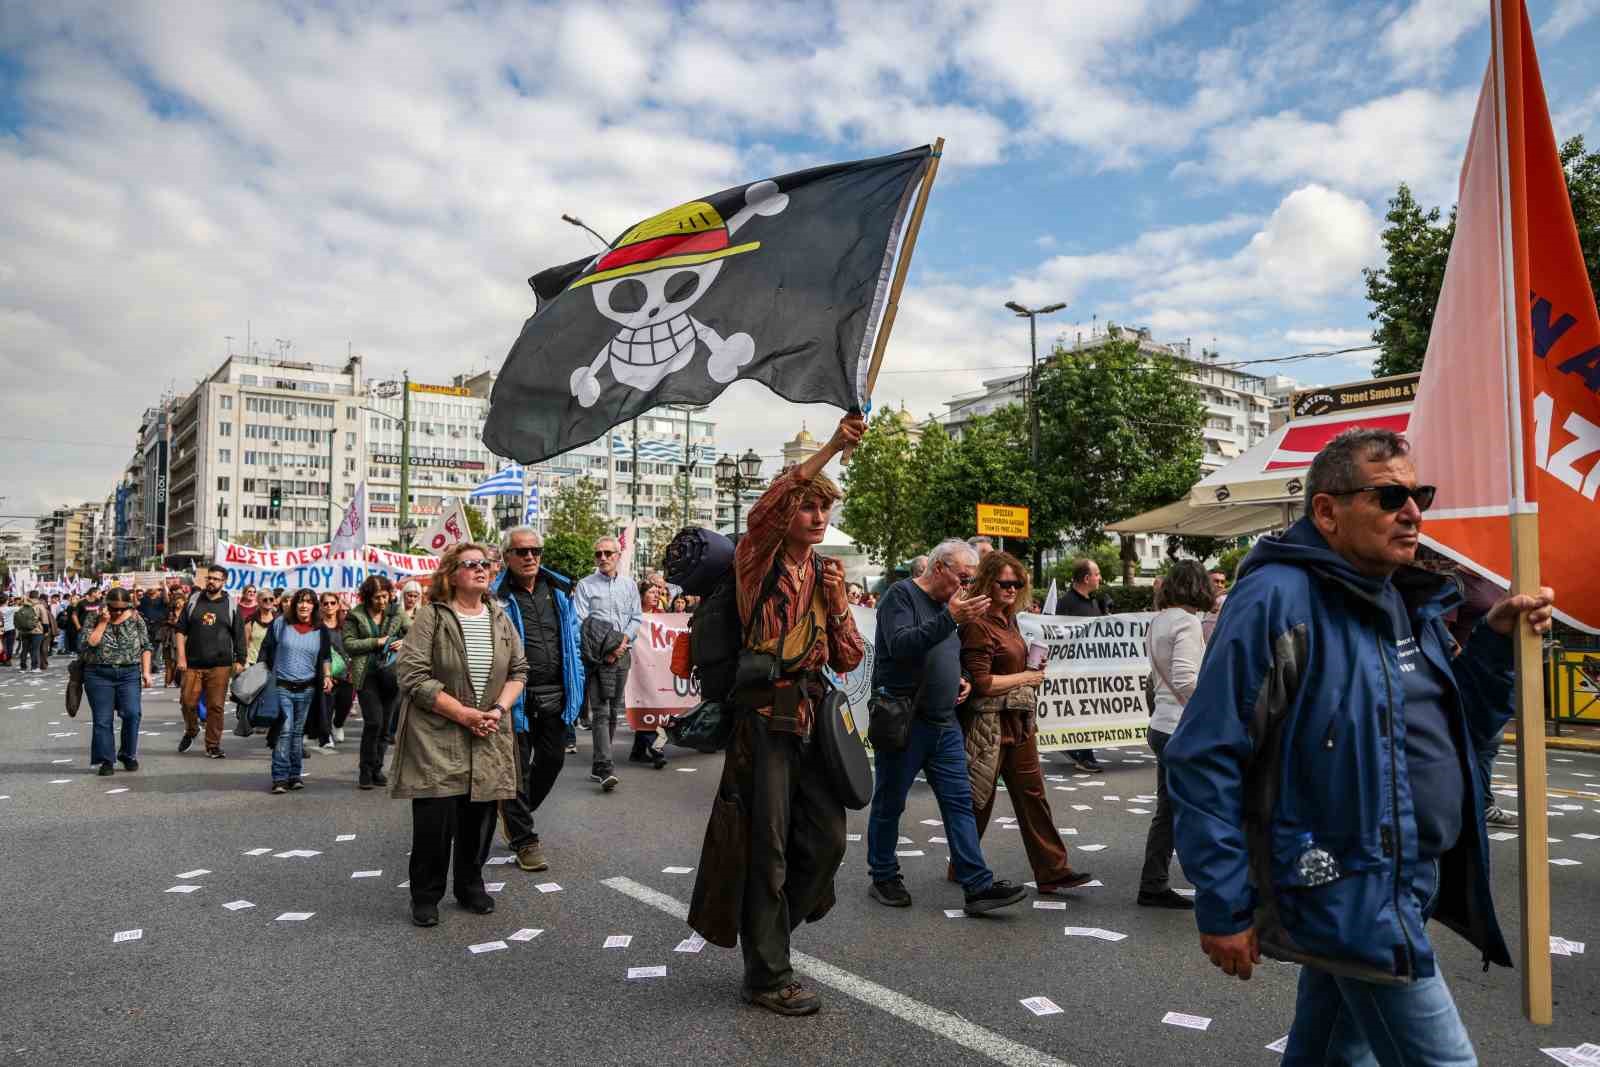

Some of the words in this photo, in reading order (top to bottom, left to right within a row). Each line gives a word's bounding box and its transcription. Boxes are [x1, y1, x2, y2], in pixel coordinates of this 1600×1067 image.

[1340, 391, 1369, 404] Street
[1370, 386, 1401, 400] Smoke
[1402, 385, 1411, 396] &
[294, 566, 332, 588] ΤΟΥ
[1041, 624, 1064, 640] ΜΕ
[1094, 621, 1124, 637] ΛΑΟ
[1053, 699, 1074, 717] ΤΑ
[1080, 696, 1143, 715] ΣΥΝΟΡΑ
[1061, 728, 1133, 745] ΑΠΟΣΤΡΑΤΩΝ
